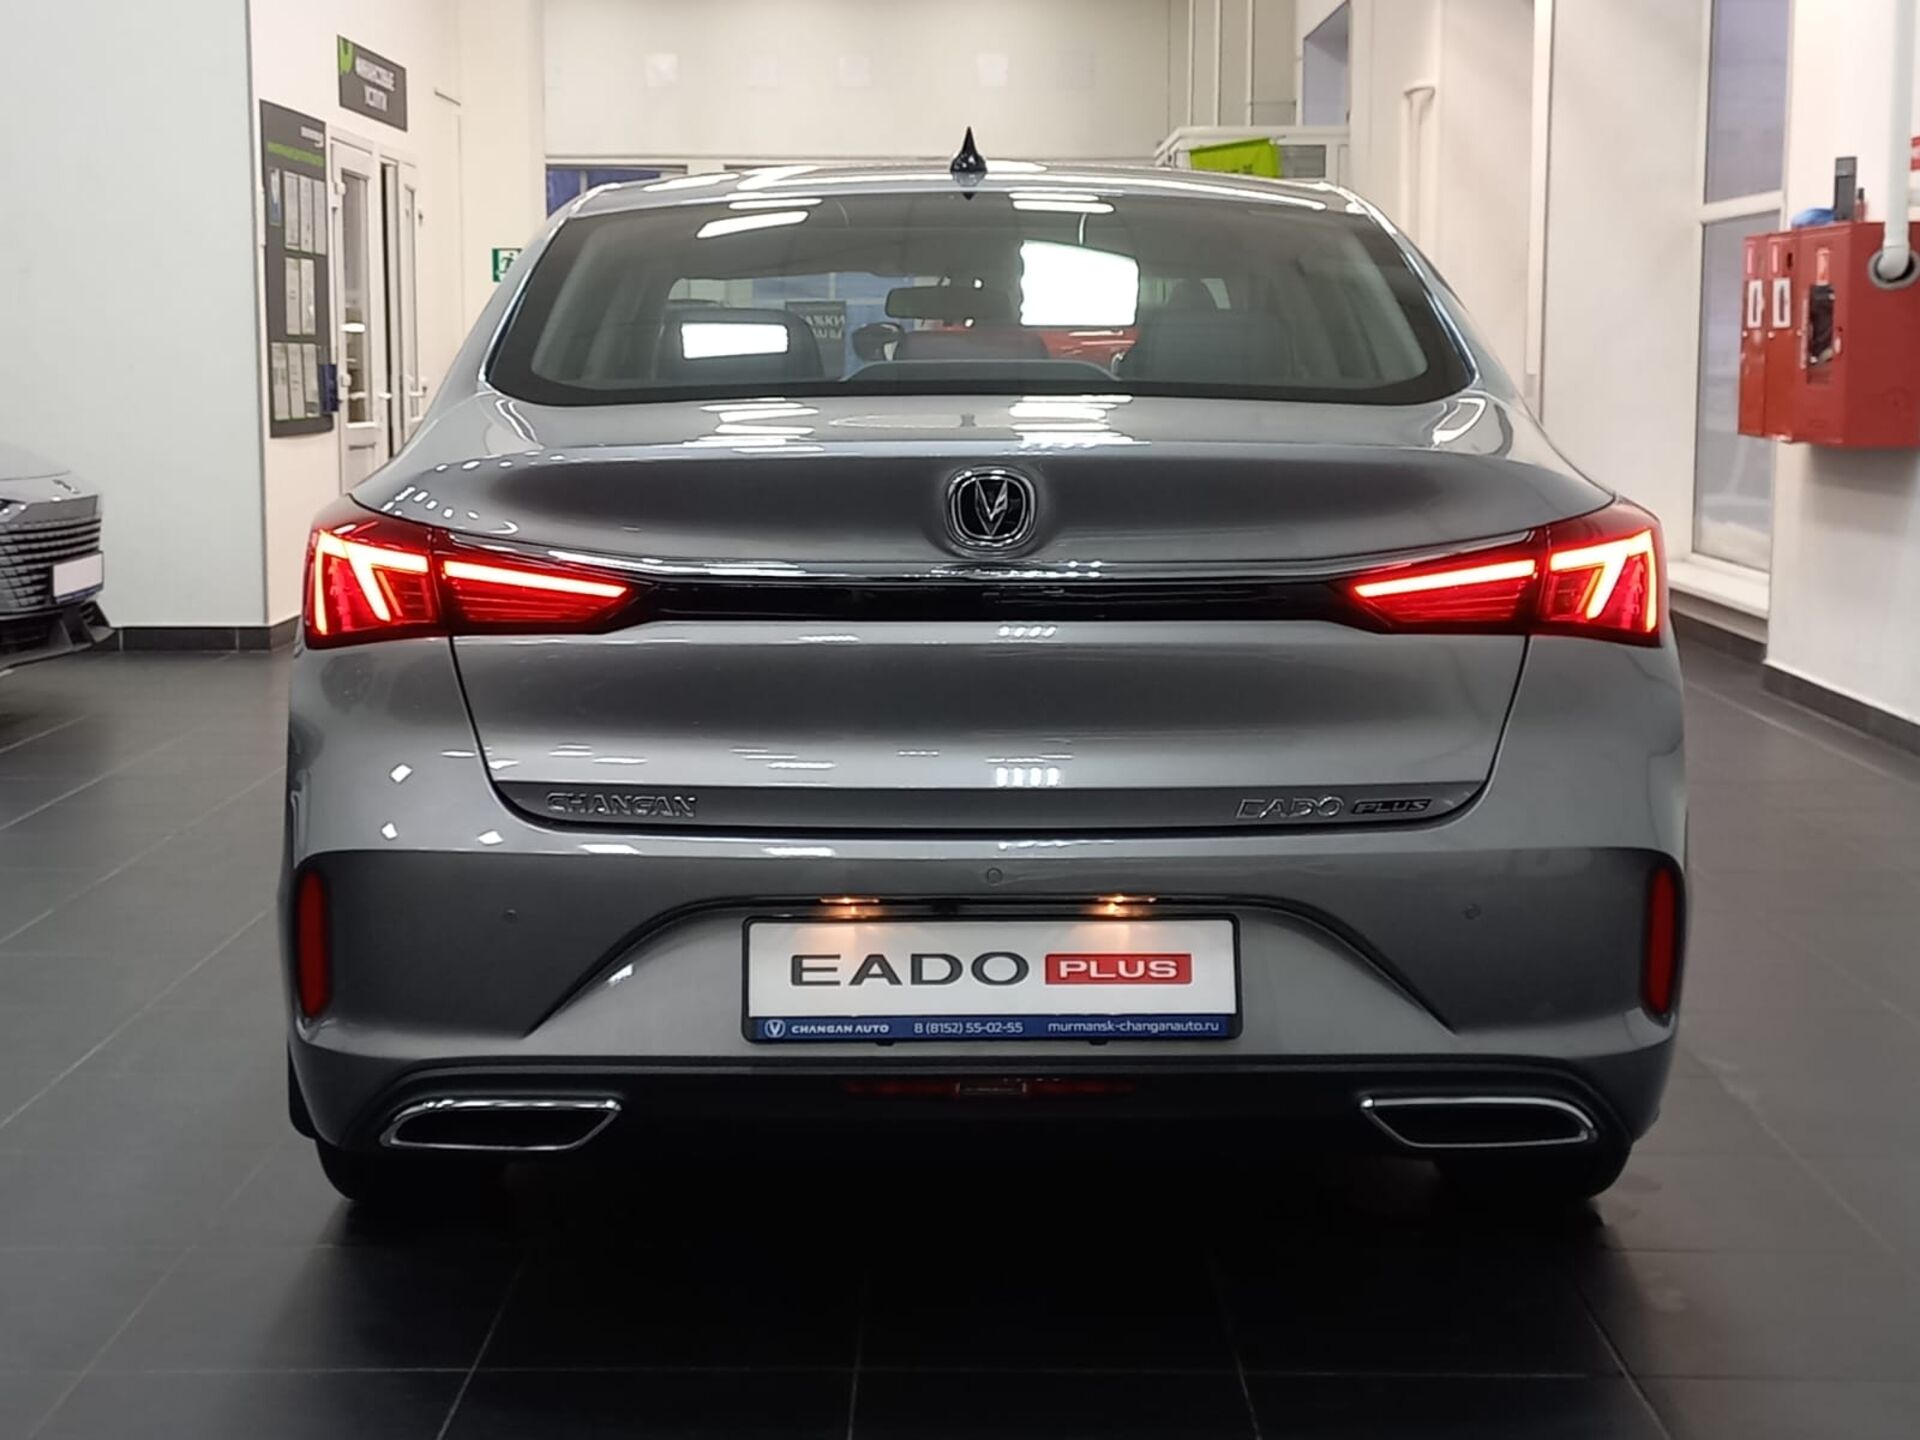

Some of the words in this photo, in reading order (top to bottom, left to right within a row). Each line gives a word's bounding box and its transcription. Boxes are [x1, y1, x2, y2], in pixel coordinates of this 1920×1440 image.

[547, 793, 695, 817] CHANGAN
[1236, 796, 1344, 818] EADO
[1353, 799, 1432, 815] PLUS
[791, 952, 1029, 986] EADO
[1059, 960, 1177, 978] PLUS
[791, 1025, 853, 1034] CHANGAN
[855, 1024, 890, 1033] AUTO
[914, 1022, 924, 1034] 8
[925, 1021, 963, 1035] (8152)
[966, 1022, 1023, 1033] 55-02-55
[1048, 1020, 1219, 1034] murmansk-changanauto.ru
